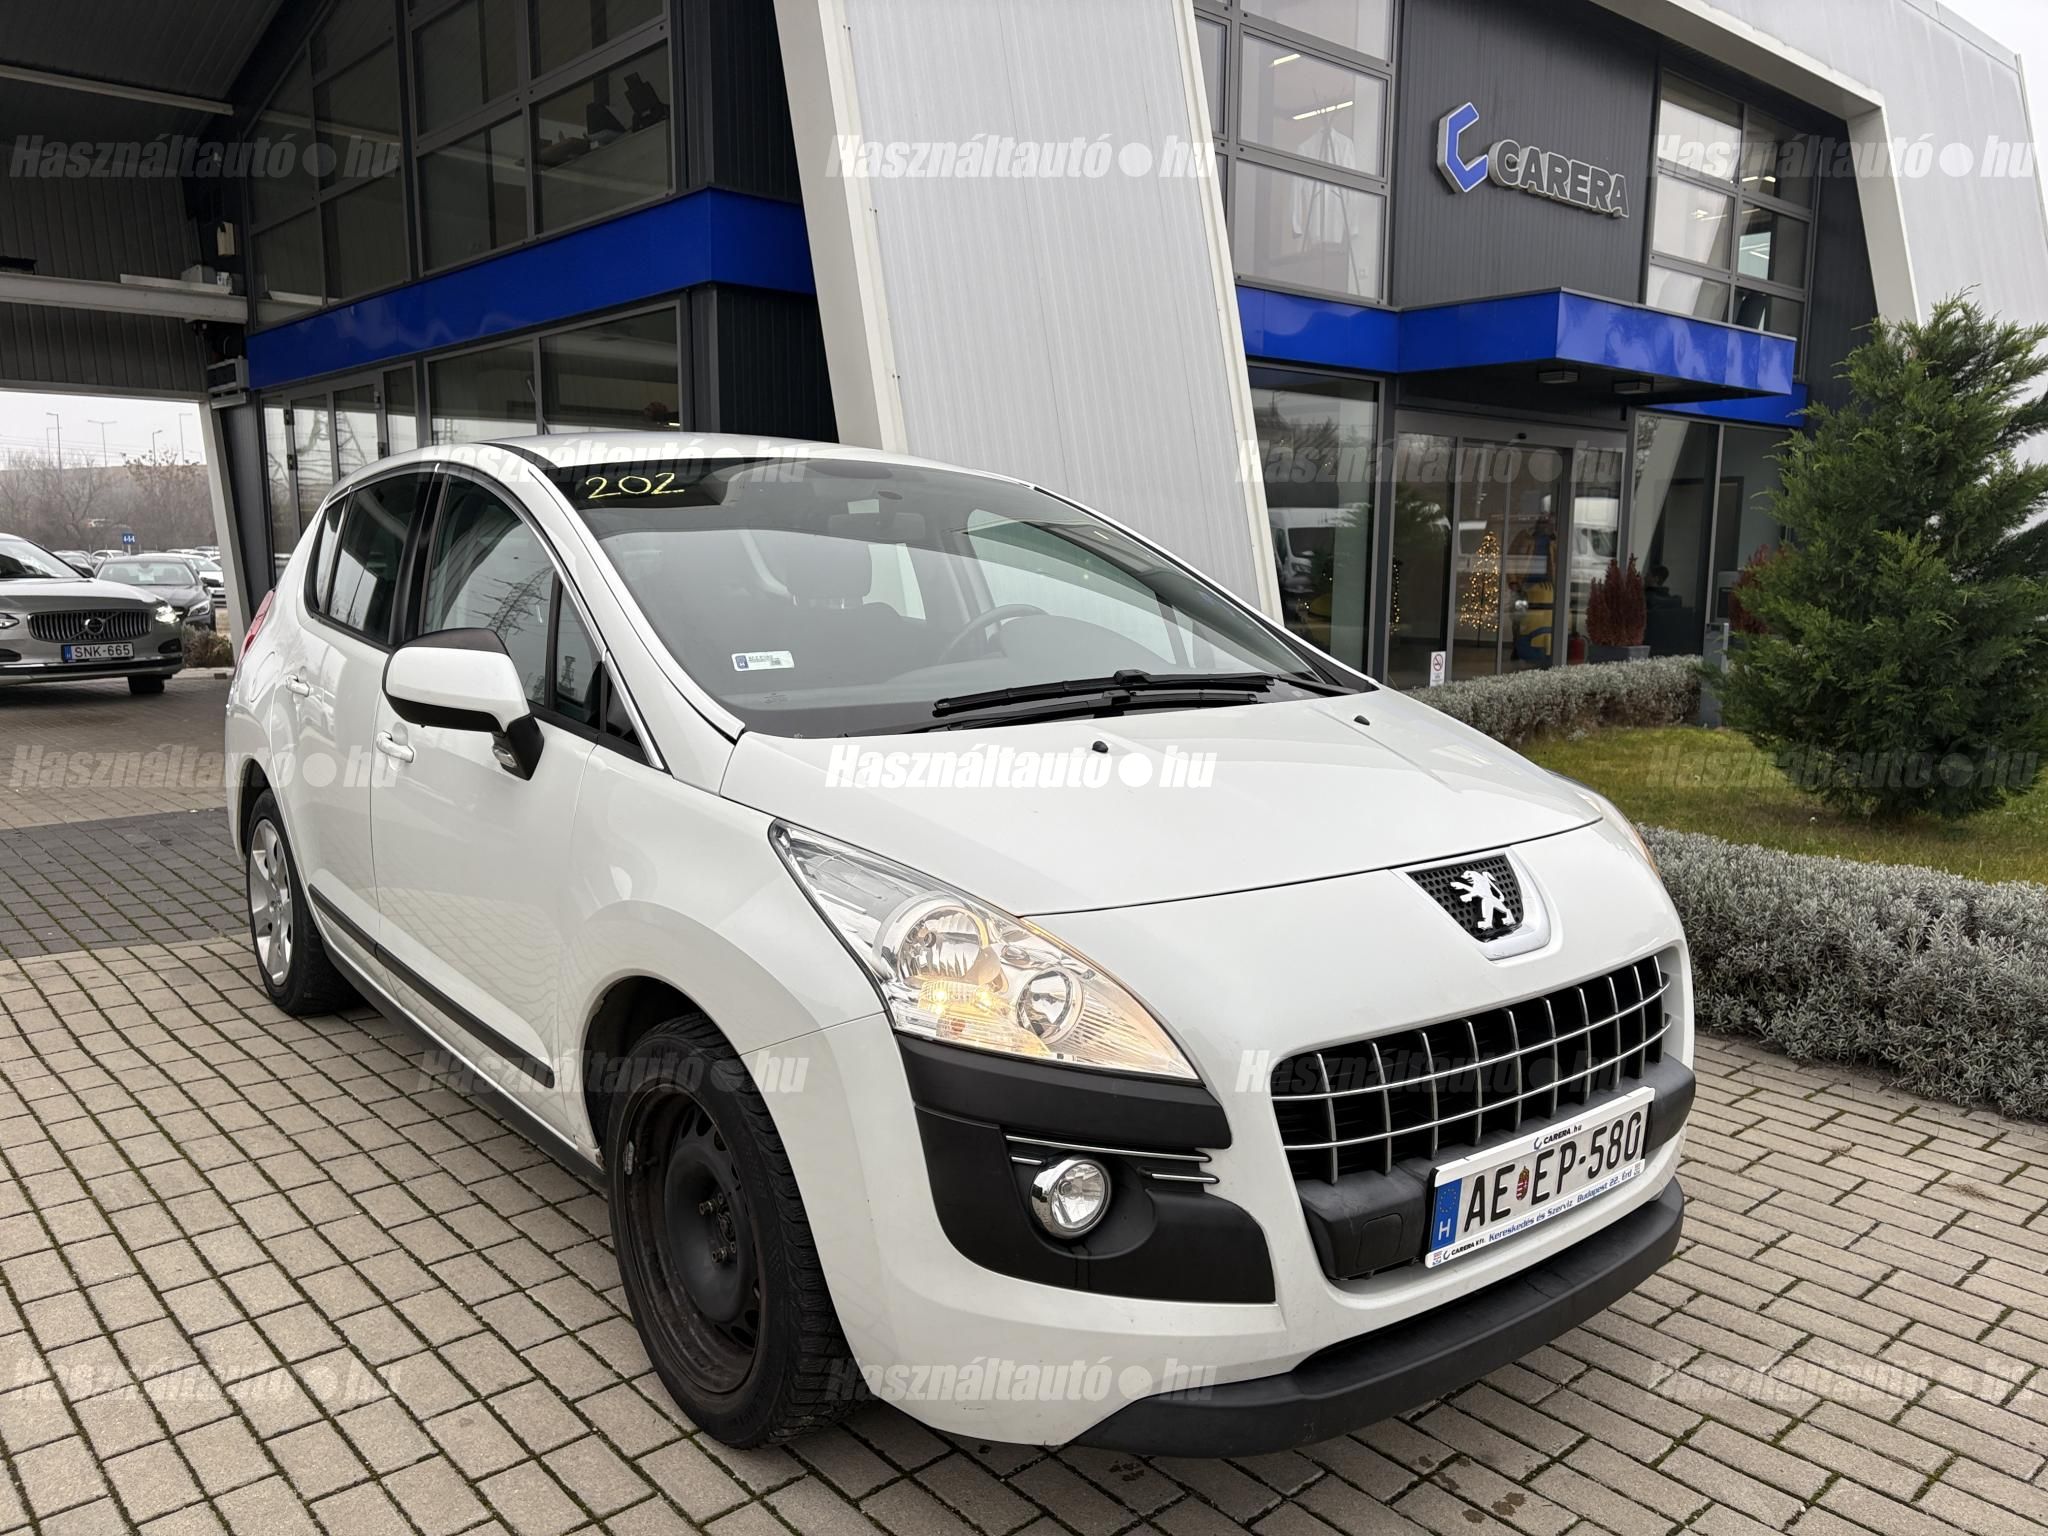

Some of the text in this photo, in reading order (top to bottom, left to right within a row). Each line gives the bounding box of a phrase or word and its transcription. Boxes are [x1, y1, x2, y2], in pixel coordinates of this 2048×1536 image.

[1490, 139, 1629, 218] CARERA
[586, 473, 685, 499] 202
[75, 645, 130, 658] SNK-665
[1438, 1218, 1451, 1241] H
